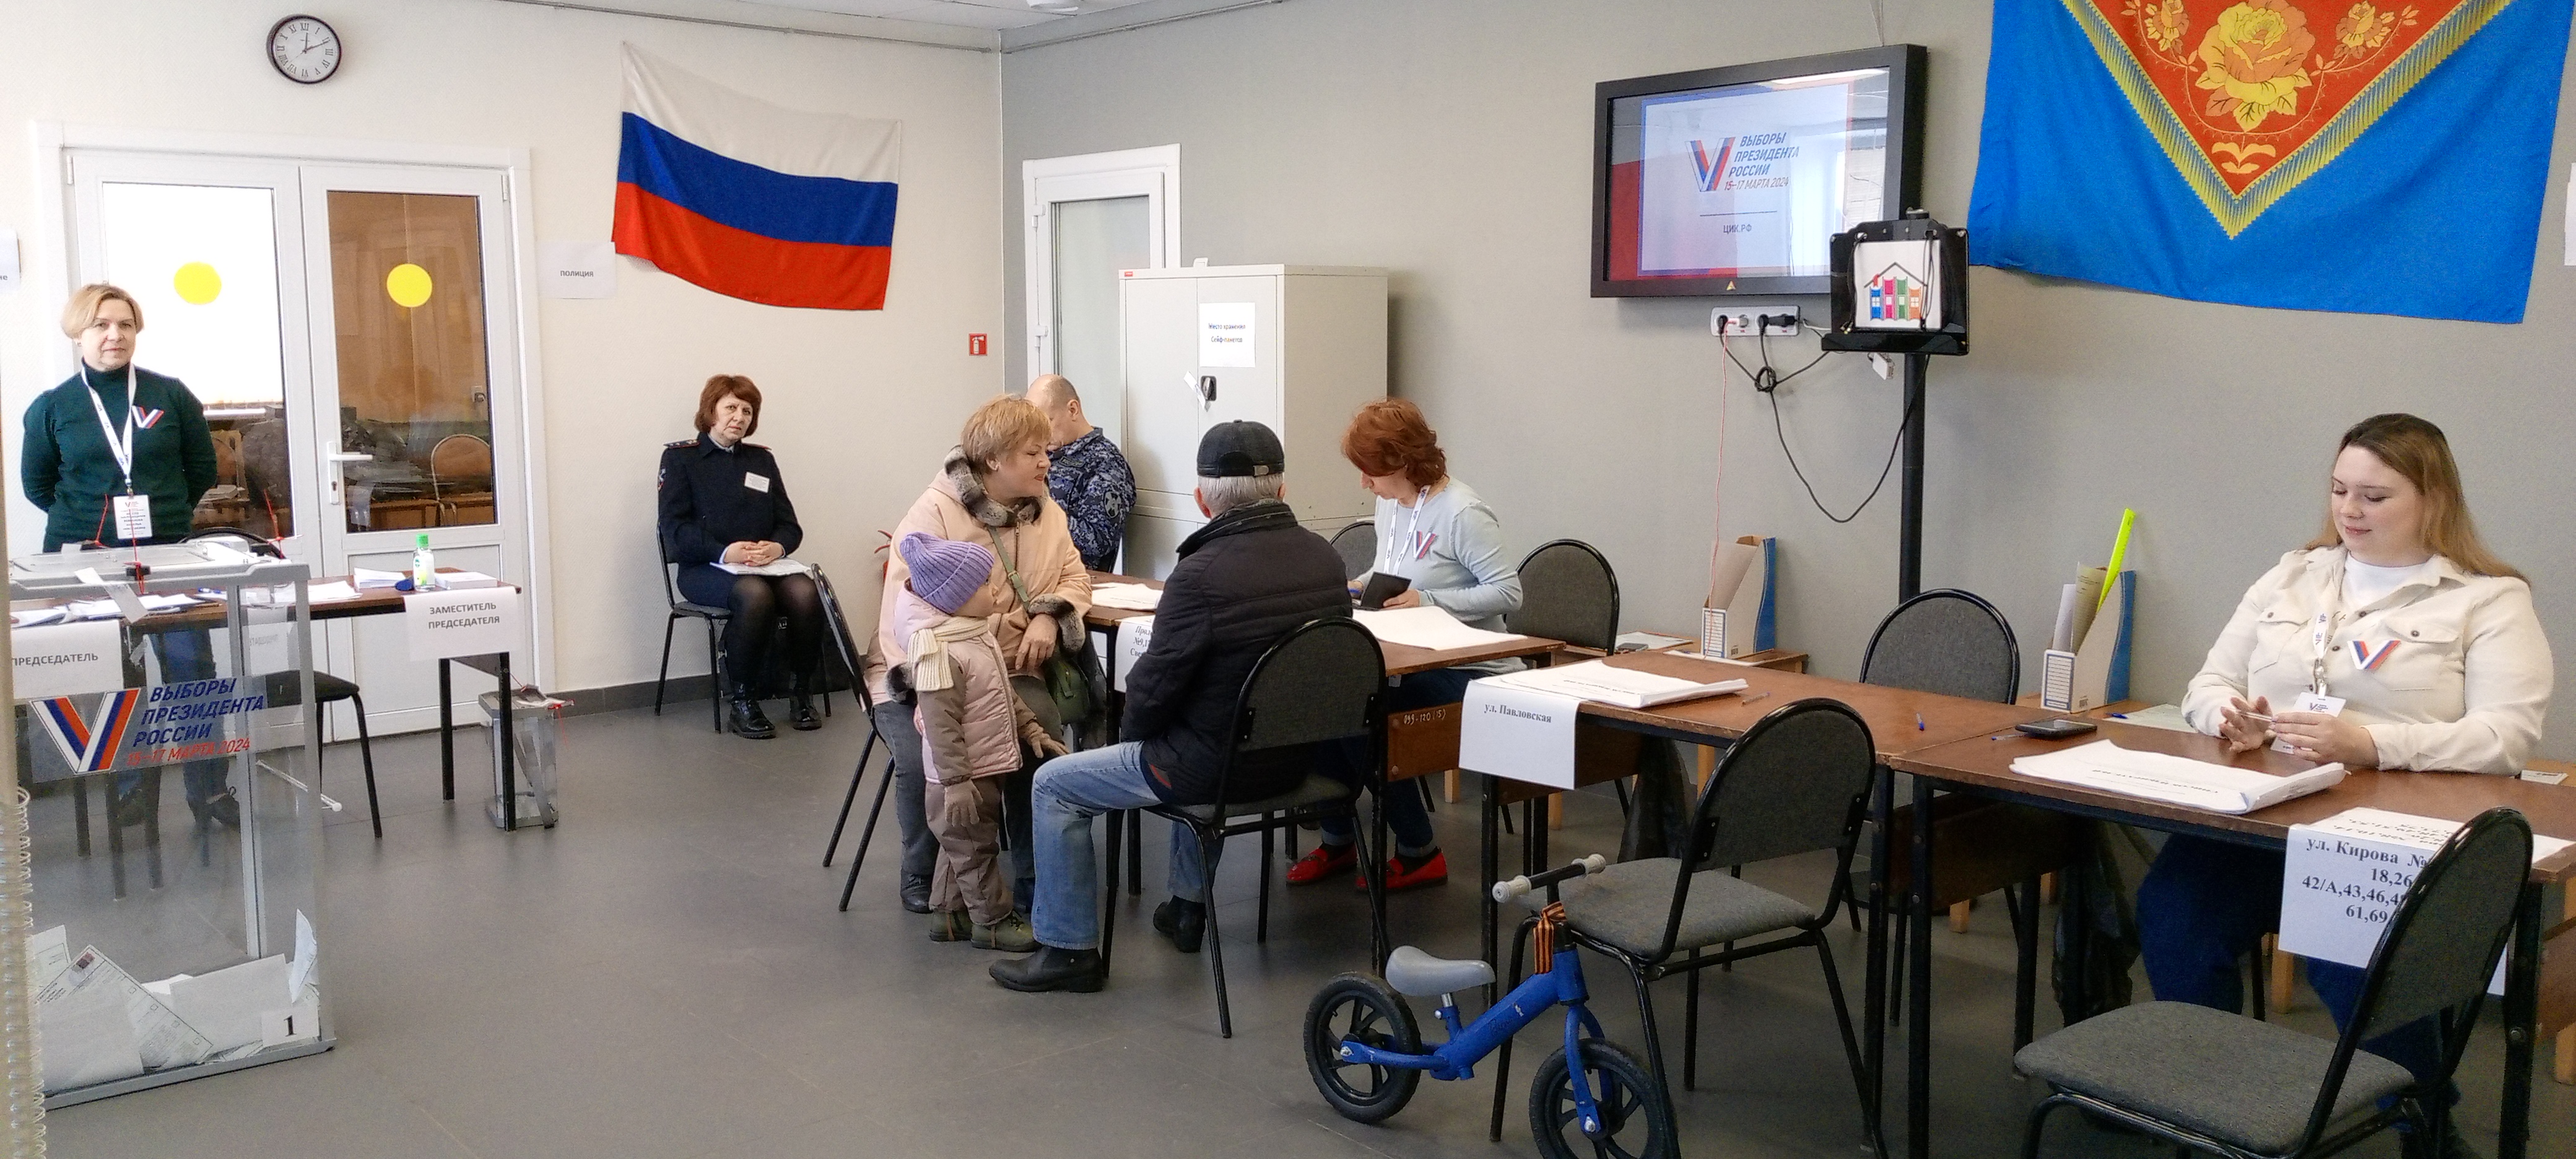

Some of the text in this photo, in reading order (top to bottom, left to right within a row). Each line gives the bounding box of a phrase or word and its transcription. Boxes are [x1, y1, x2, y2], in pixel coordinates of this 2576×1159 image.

[1739, 132, 1786, 147] ВЫБОРЫ
[1734, 146, 1799, 162] ПРЕЗИДЕНТА
[1728, 163, 1770, 178] РОССИИ
[1744, 178, 1770, 189] МАРТА
[1770, 176, 1789, 188] 2024
[1723, 224, 1752, 235] ЦИК.РФ
[430, 602, 497, 615] ЗАМЕСТИТЕЛЬ
[429, 616, 500, 630] ПРЕДСЕДАТЕЛЯ
[150, 678, 237, 703] ВЫБОРЫ
[141, 695, 264, 725] ПРЕЗИДЕНТА
[1484, 704, 1551, 723] ул. Павловская
[133, 723, 213, 747] РОССИИ
[168, 742, 215, 761] МАРТА
[217, 738, 250, 754] 2024
[2306, 838, 2330, 851] ул.
[2336, 840, 2399, 864] Кирова
[2302, 875, 2404, 907] 42/А,43,46,4
[284, 1015, 297, 1037] 1
